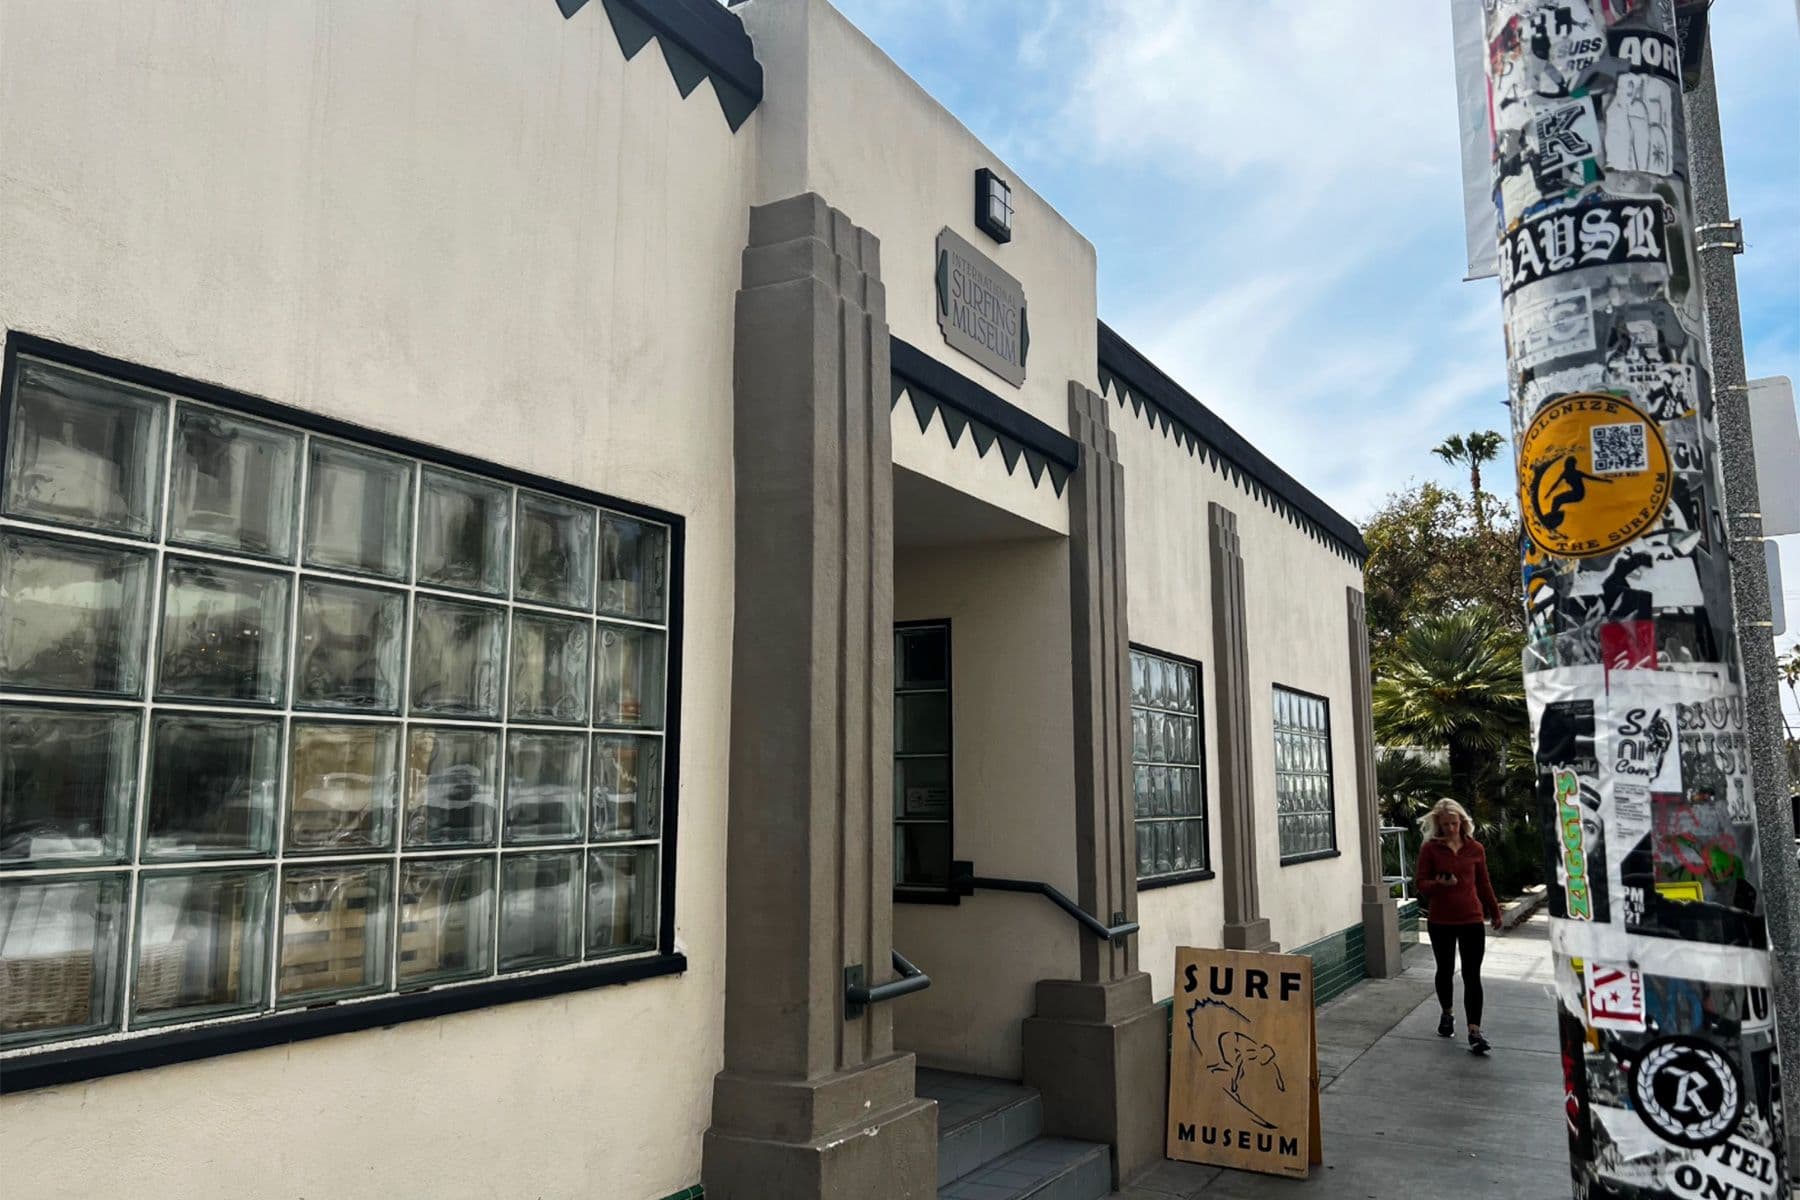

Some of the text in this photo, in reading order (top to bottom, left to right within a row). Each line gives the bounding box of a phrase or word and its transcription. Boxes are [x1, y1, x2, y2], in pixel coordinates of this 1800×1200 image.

[951, 269, 1017, 337] SURFING
[952, 300, 1017, 367] MUSEUM
[1556, 539, 1600, 551] THE
[1554, 770, 1592, 919] ZIGGY'S
[1184, 964, 1302, 1001] SURF
[1178, 1123, 1298, 1157] MUSEUM
